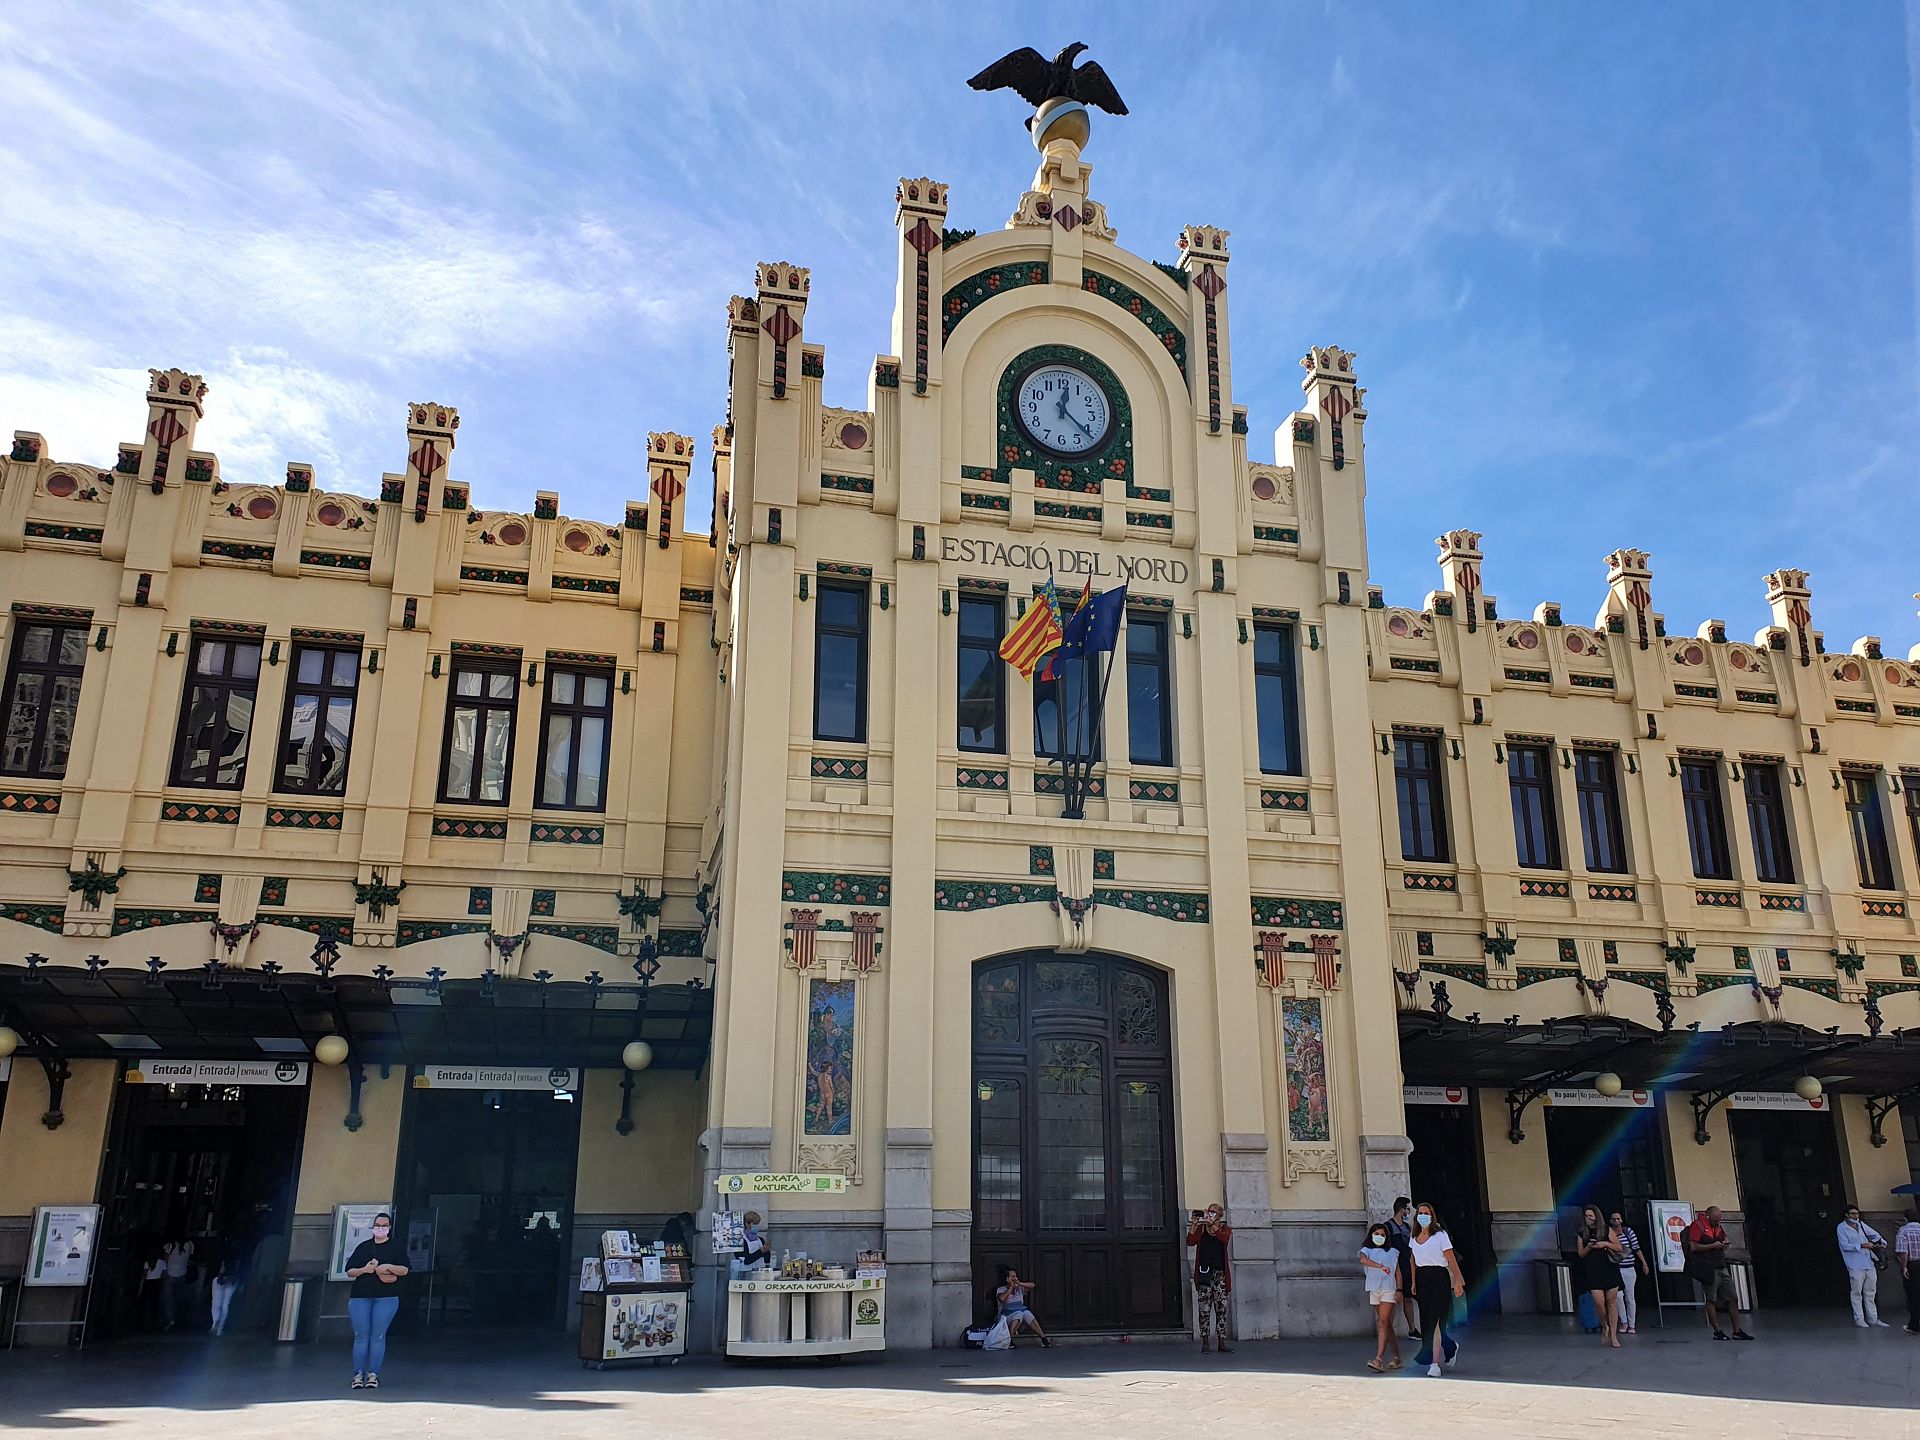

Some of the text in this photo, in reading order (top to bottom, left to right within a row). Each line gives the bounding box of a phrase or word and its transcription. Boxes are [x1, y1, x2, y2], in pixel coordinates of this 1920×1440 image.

[1044, 380, 1053, 392] 11
[1057, 378, 1070, 390] 12
[1076, 384, 1080, 396] 1
[1031, 389, 1045, 401] 10
[1084, 395, 1092, 407] 2
[1028, 401, 1037, 413] 9
[1031, 415, 1041, 427] 8
[1087, 410, 1096, 422] 3
[1043, 428, 1052, 440] 7
[1083, 423, 1093, 436] 4
[1057, 434, 1067, 446] 6
[1072, 433, 1081, 445] 5
[940, 536, 1189, 584] ESTACIÓ DEL NORD
[152, 1064, 269, 1077] Entrada Entrada ENTRANCE
[437, 1070, 473, 1081] Entrada
[479, 1071, 513, 1082] Entrada
[753, 1174, 800, 1182] ORXATA
[753, 1178, 811, 1191] NATURAL ECO
[765, 1282, 804, 1291] ORXATA
[806, 1282, 845, 1290] NATURAL
